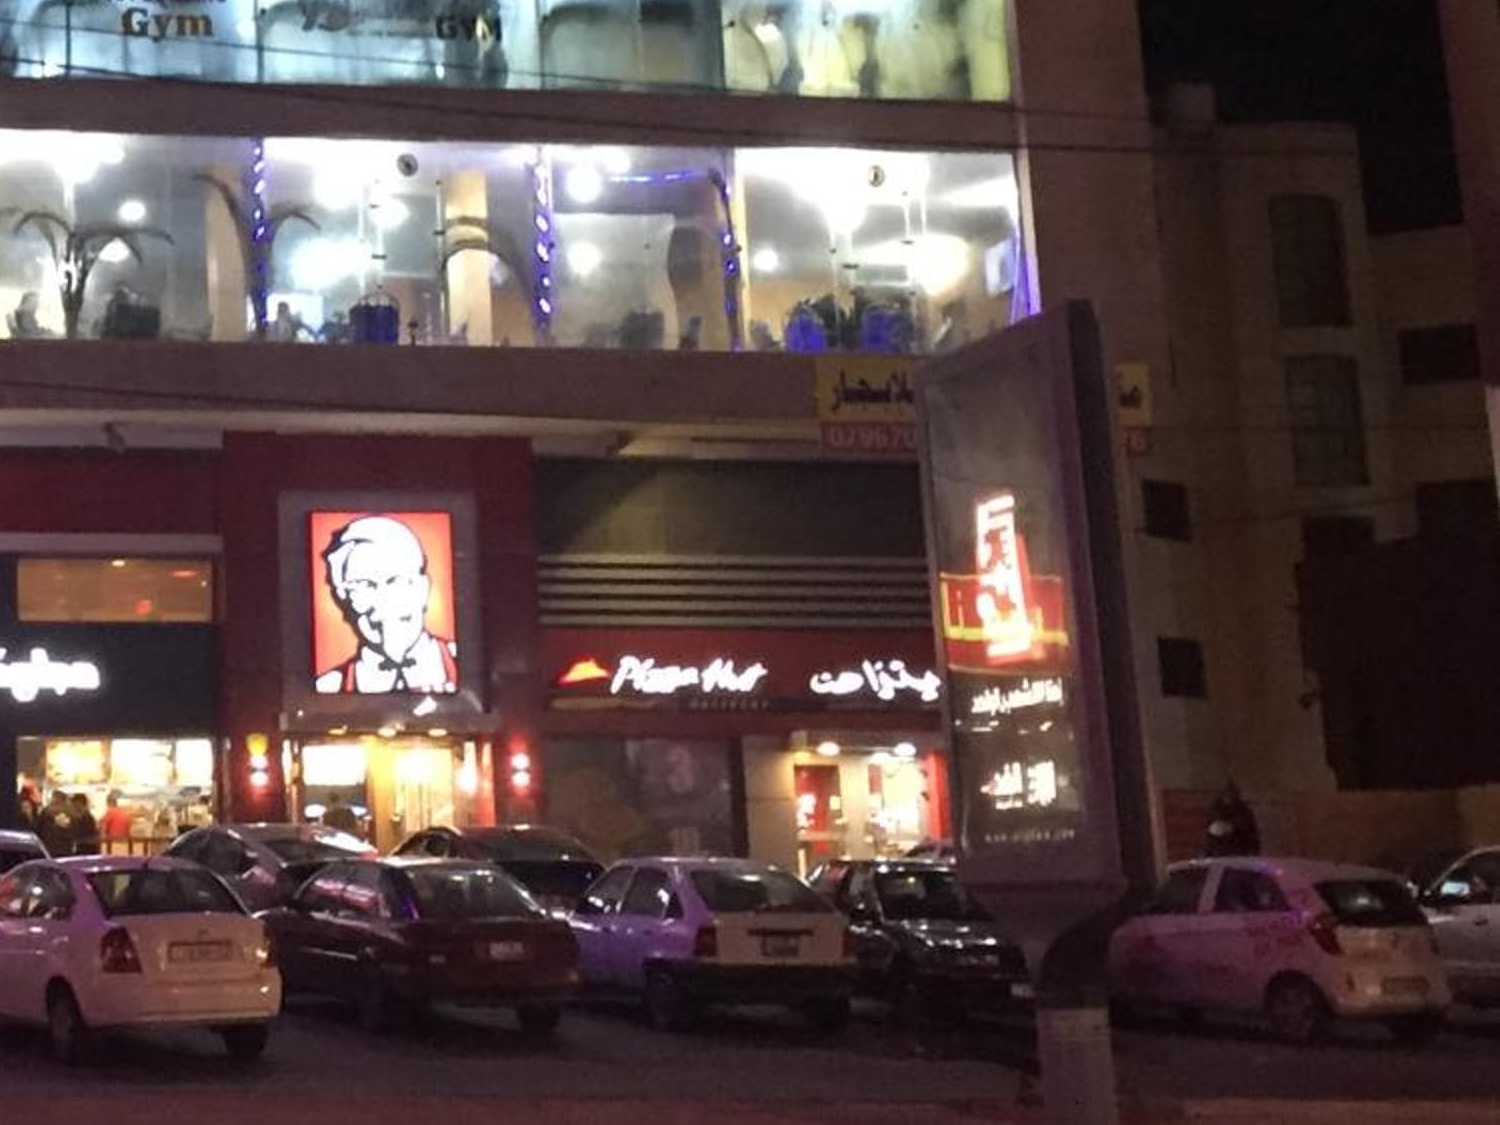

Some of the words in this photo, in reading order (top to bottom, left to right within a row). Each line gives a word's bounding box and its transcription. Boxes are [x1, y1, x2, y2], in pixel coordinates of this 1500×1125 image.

[121, 6, 213, 43] Gym
[611, 655, 698, 694] Pizza
[700, 657, 768, 693] Hut
